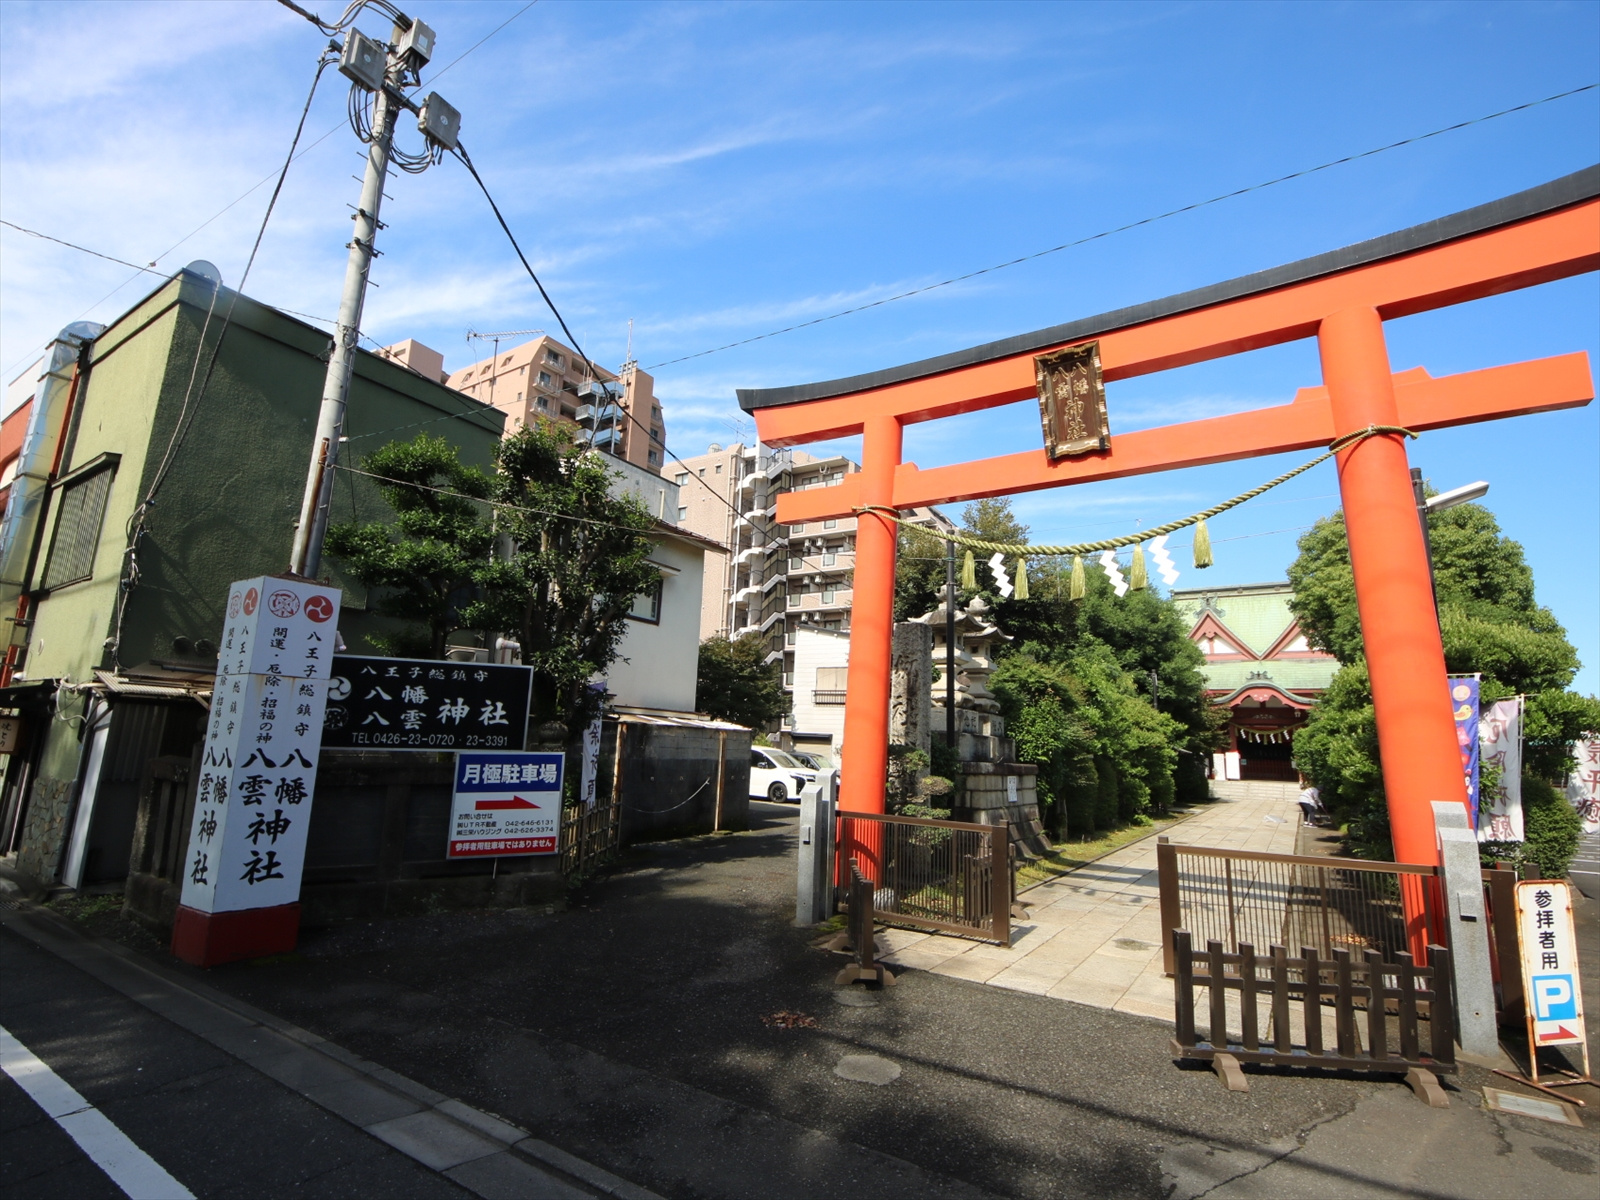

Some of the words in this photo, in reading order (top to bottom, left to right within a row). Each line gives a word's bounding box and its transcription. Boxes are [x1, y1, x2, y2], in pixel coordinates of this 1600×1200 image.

[226, 625, 249, 736] 八王子総鎮守
[255, 627, 288, 744] 開運・厄除・招福の神
[294, 631, 322, 737] 八王子総鎮守
[360, 665, 488, 682] 八王子総鎮守
[352, 732, 370, 744] TEL
[466, 735, 508, 746] 23-3391
[462, 763, 558, 785] 月極駐車場
[455, 838, 553, 853] 参拝者用駐車場ではありません
[1534, 889, 1560, 970] 参拝者用
[1535, 978, 1572, 1018] P
